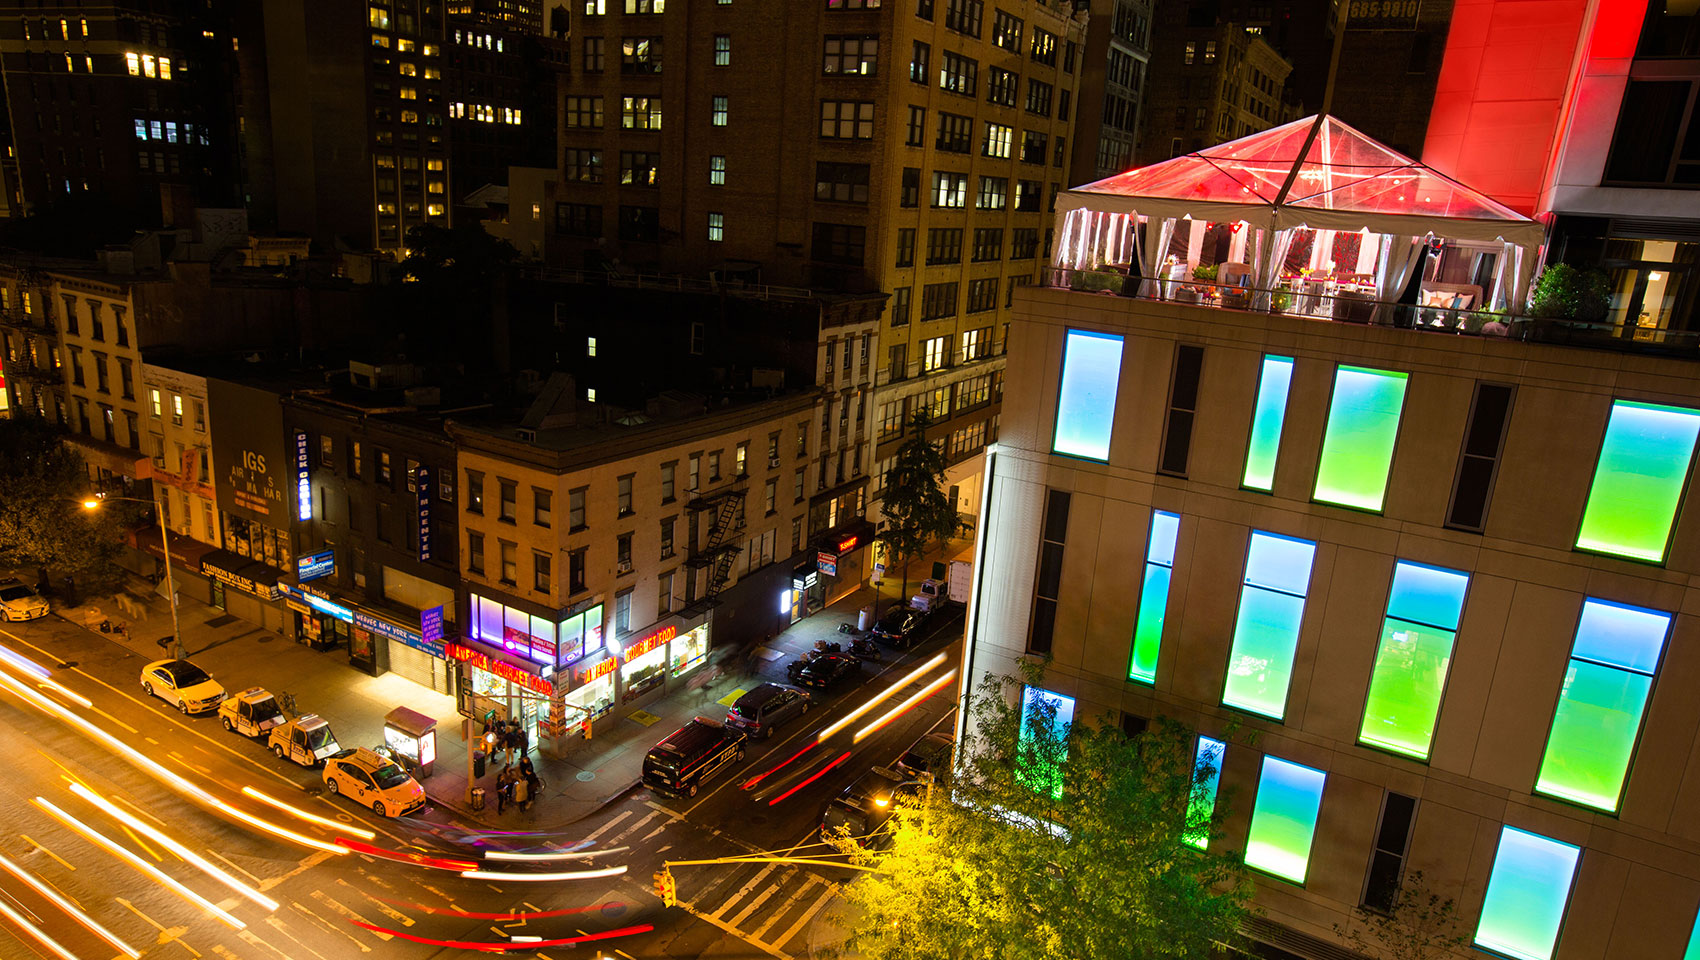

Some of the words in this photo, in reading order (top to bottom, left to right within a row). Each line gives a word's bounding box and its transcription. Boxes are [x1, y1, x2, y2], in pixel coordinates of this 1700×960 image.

[243, 450, 267, 474] IGS
[420, 510, 429, 560] CENTER
[202, 561, 228, 577] FASHION
[228, 572, 241, 583] BOX
[298, 583, 310, 593] ATM
[355, 613, 377, 627] WEAVES
[378, 621, 391, 631] NEW
[392, 627, 407, 639] YORK
[584, 655, 618, 684] AMERICA
[624, 634, 657, 663] GOURMET
[658, 625, 676, 647] FOOD
[530, 674, 553, 697] FOOD
